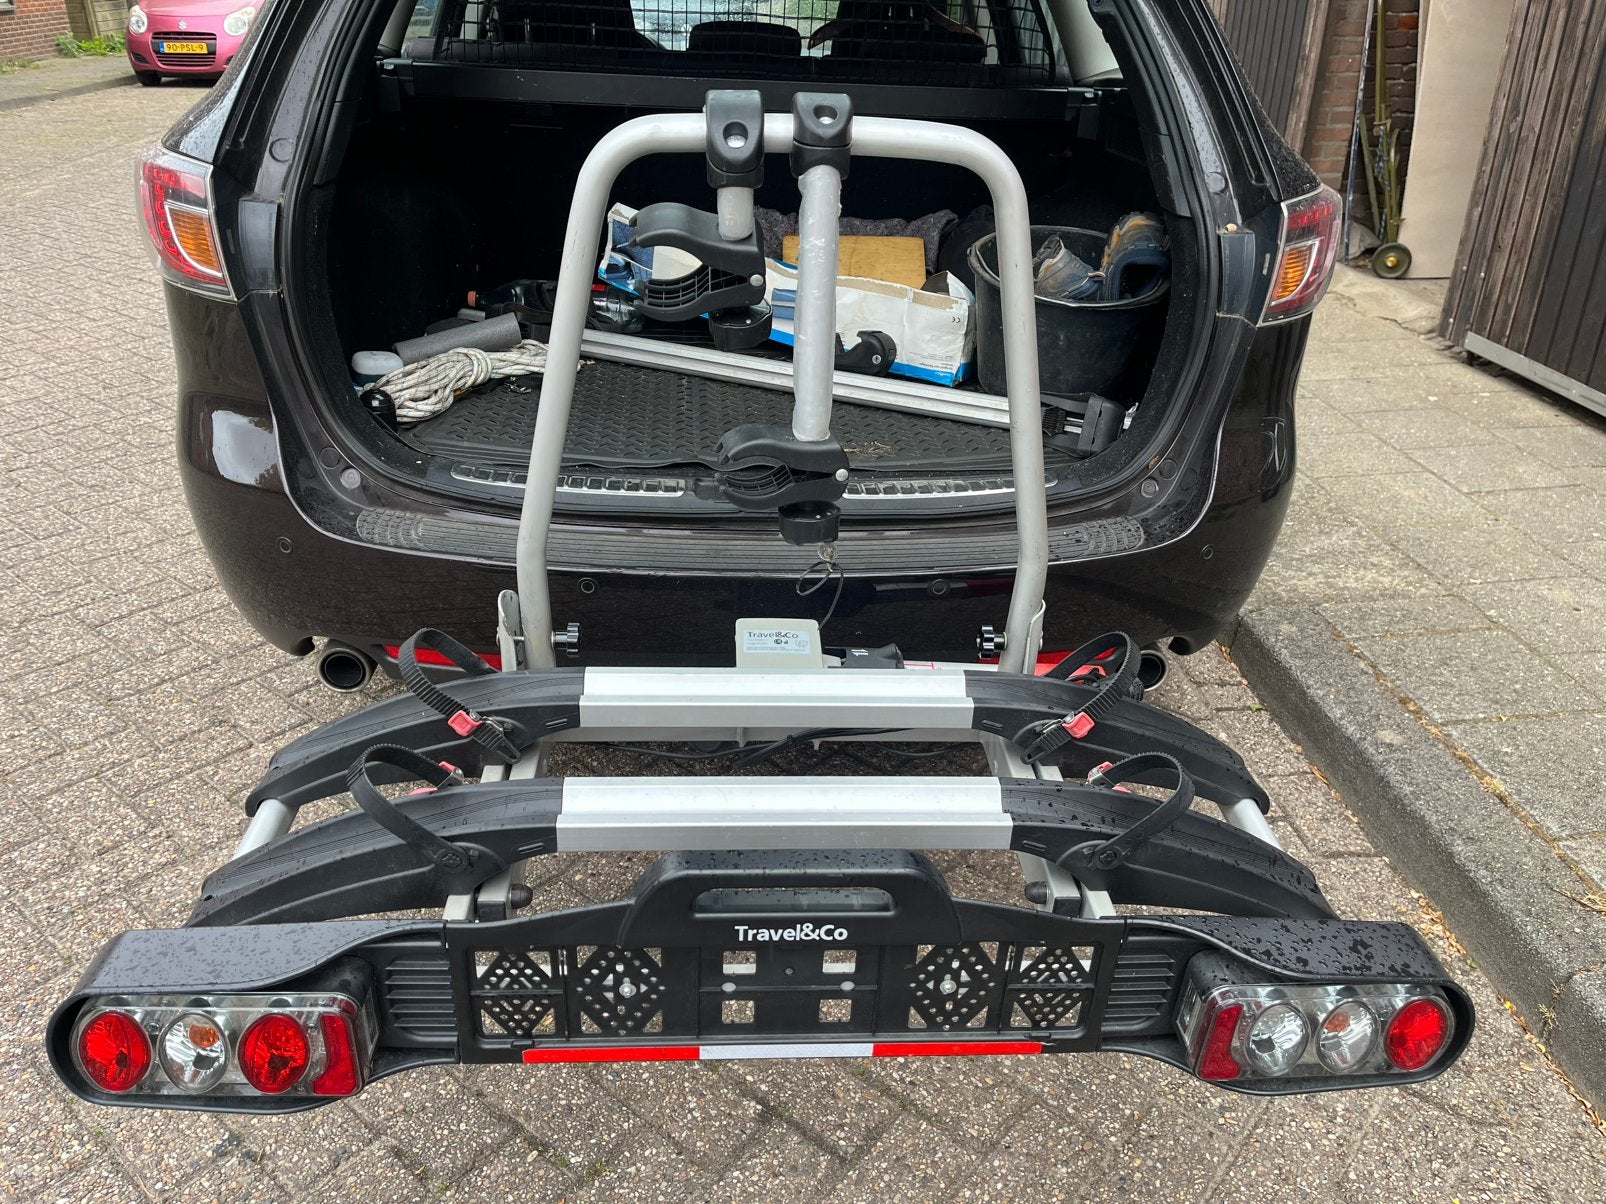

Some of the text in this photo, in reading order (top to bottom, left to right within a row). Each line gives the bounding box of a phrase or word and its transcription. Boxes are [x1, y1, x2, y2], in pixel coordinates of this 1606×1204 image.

[166, 44, 203, 52] 90-PSL-9
[747, 631, 799, 639] Travel&Co
[734, 922, 848, 942] Travel&Co
